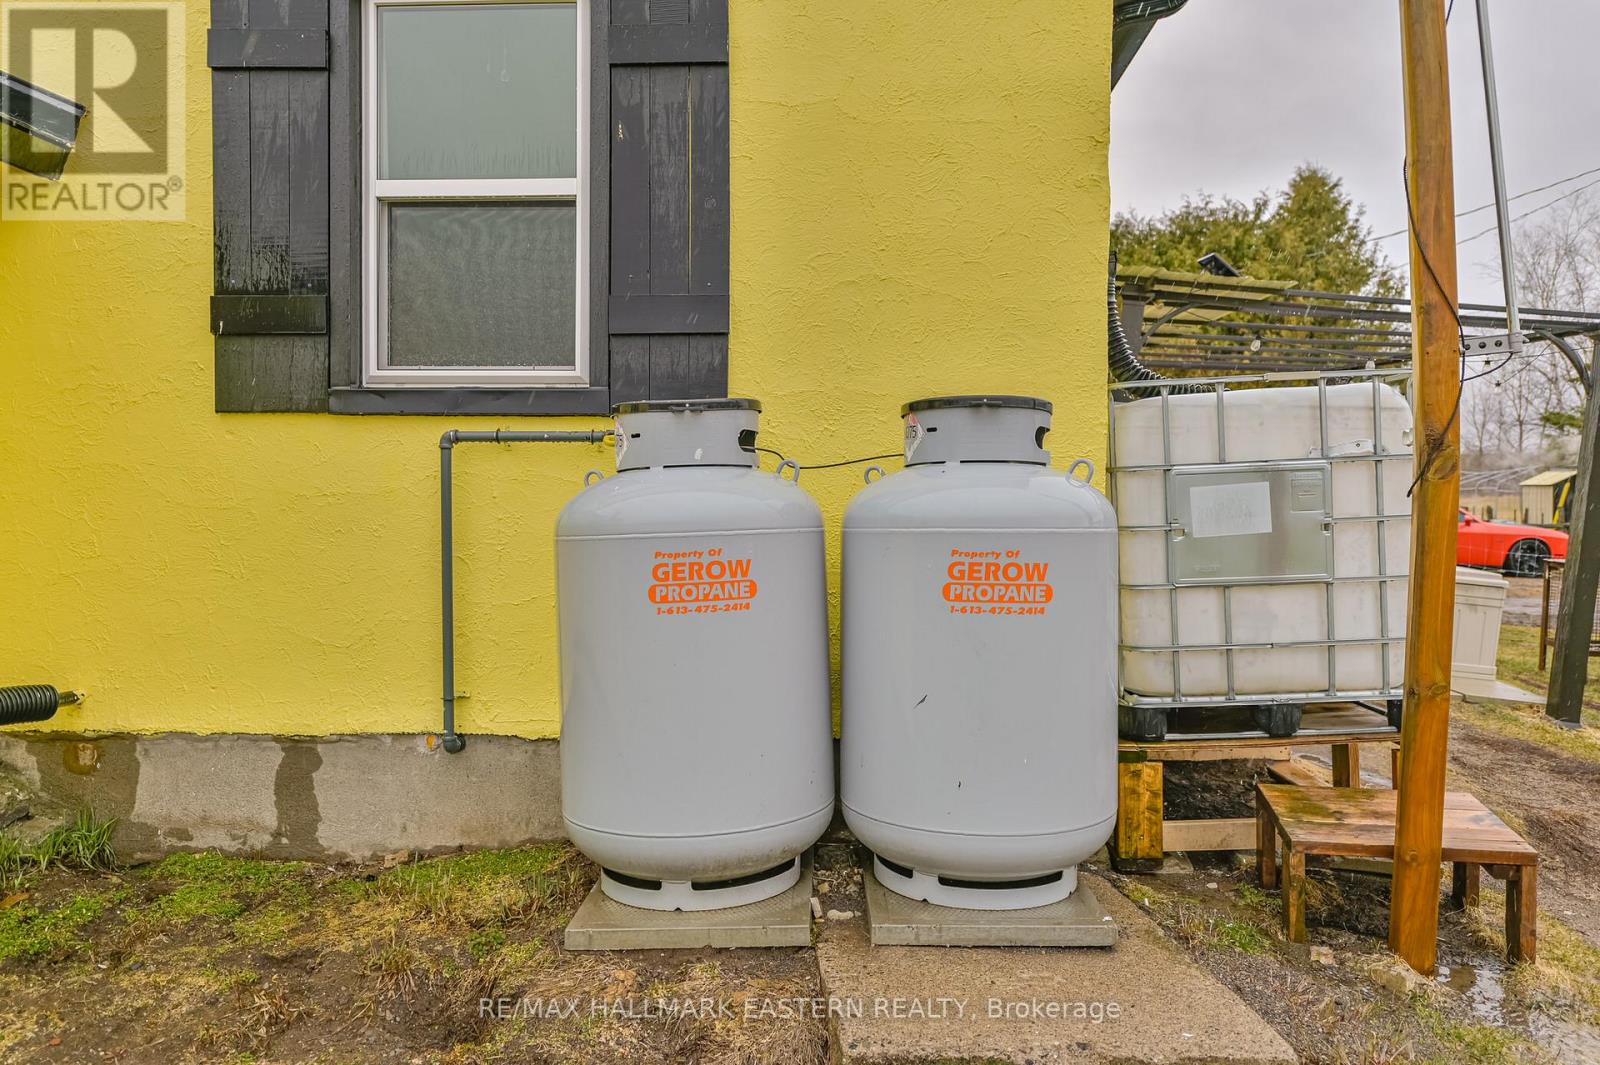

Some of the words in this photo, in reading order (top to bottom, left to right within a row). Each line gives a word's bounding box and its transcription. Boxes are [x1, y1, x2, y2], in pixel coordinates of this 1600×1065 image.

[655, 550, 704, 560] Property
[708, 548, 722, 557] Of
[951, 549, 1001, 560] Property
[1006, 550, 1021, 559] Of
[652, 559, 752, 582] GEROW
[947, 561, 1049, 582] GEROW
[655, 582, 751, 602] PROPANE
[950, 584, 1047, 602] PROPANE
[656, 602, 751, 615] 1-613-475-2414
[950, 605, 1046, 615] 1-613-475-2414
